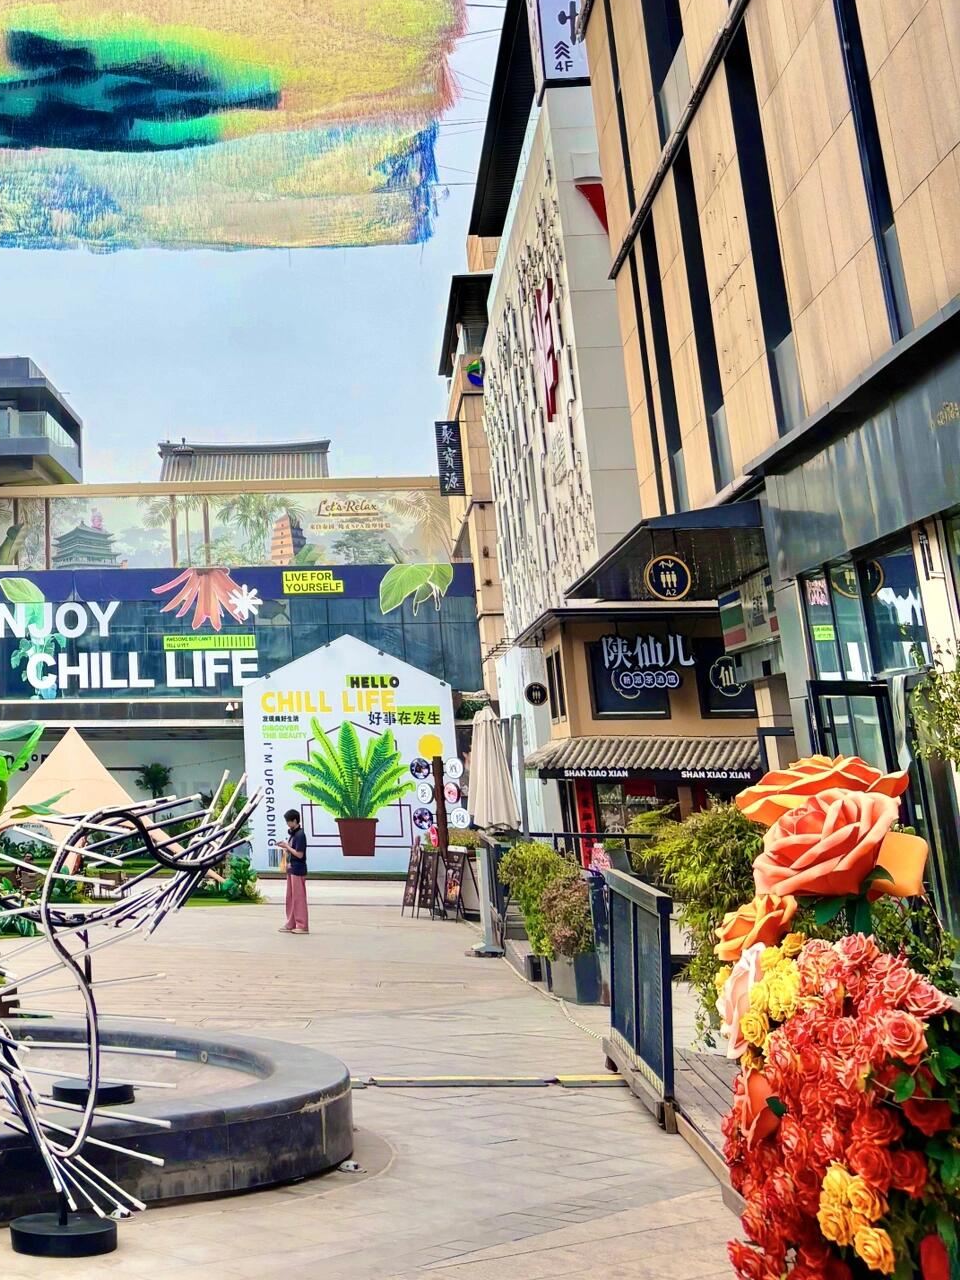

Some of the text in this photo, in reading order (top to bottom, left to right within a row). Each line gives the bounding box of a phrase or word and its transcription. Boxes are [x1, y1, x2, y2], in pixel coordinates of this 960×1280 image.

[555, 61, 573, 72] 4F
[343, 500, 377, 512] Relax
[285, 572, 332, 582] LIVE FOR
[285, 582, 342, 592] YOURSELF
[601, 634, 696, 669] 陕仙儿
[26, 650, 260, 689] CHILL LIFE
[350, 676, 400, 688] HELLO
[261, 690, 397, 714] CHILL LIFE
[368, 711, 441, 726] 好事在发生
[706, 771, 727, 779] XIAO
[729, 771, 751, 779] XIAN
[264, 769, 277, 847] UPGRADING
